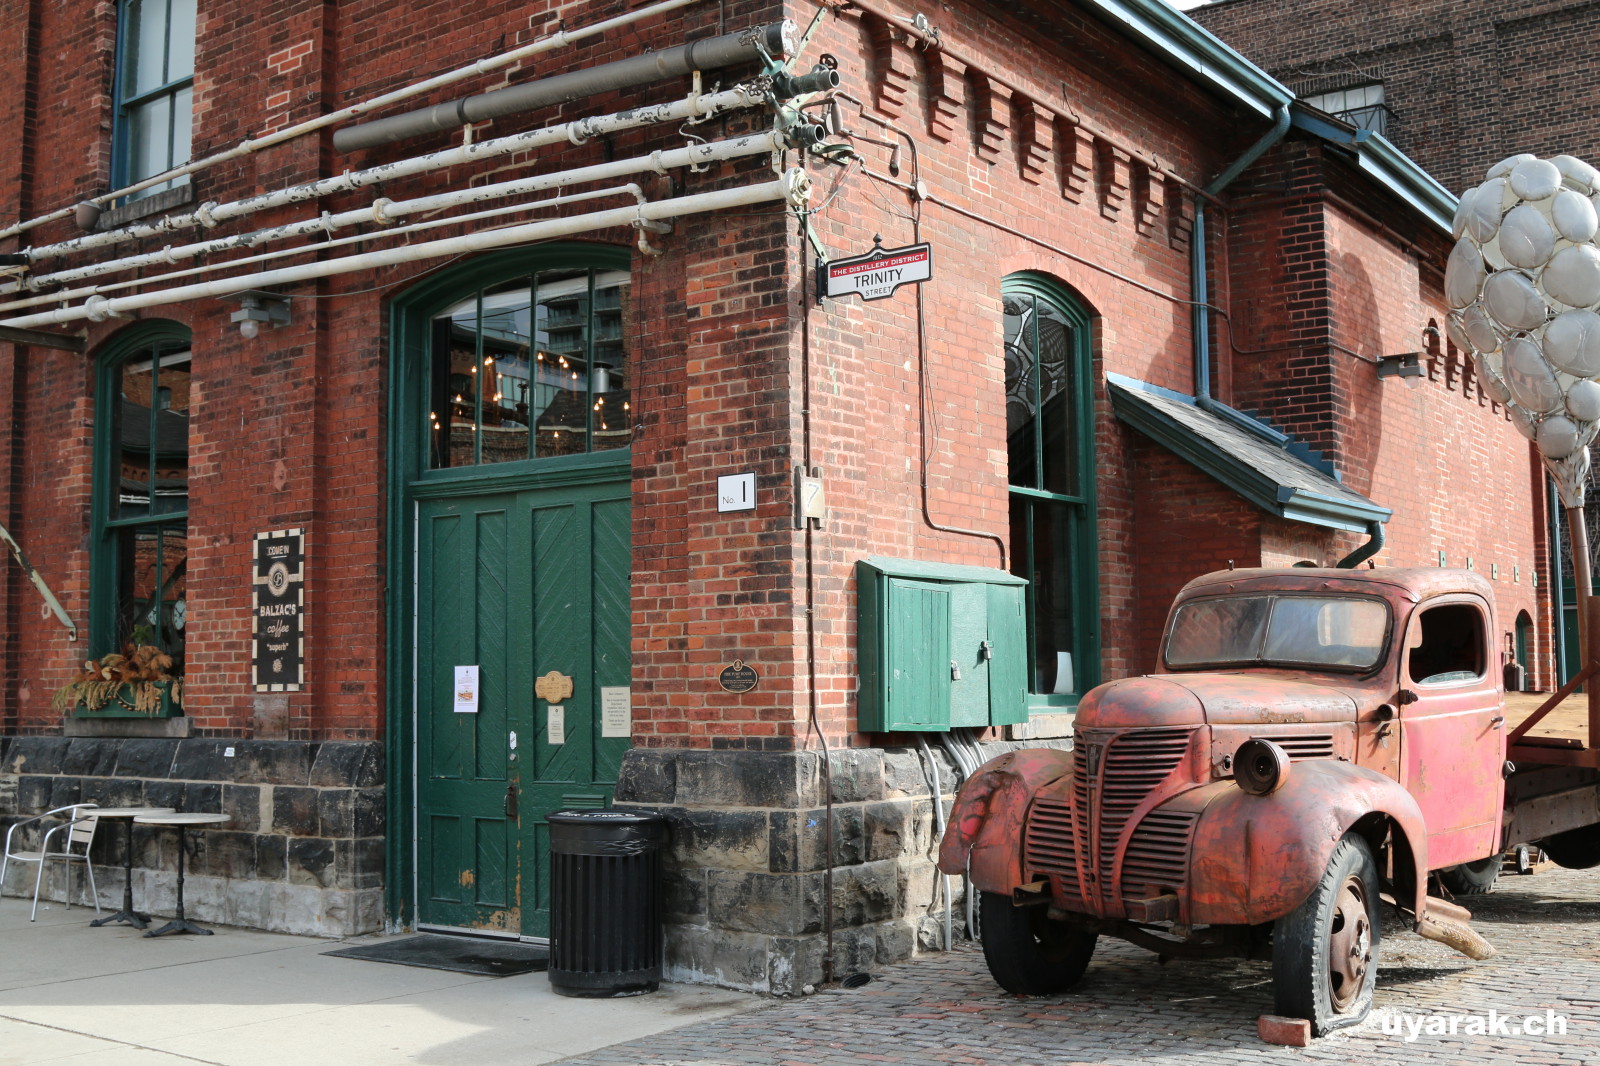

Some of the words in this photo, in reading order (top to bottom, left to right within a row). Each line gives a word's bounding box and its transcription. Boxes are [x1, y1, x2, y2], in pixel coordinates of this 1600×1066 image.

[849, 261, 889, 273] DISTILLERY
[891, 253, 925, 265] DISTRICT
[854, 268, 903, 288] TRINITY
[865, 286, 892, 297] STREET
[722, 496, 736, 504] No.
[742, 480, 746, 502] 1
[805, 482, 820, 512] 7
[266, 545, 284, 556] COME
[260, 604, 296, 617] BALZAC'S
[267, 619, 290, 637] coffee
